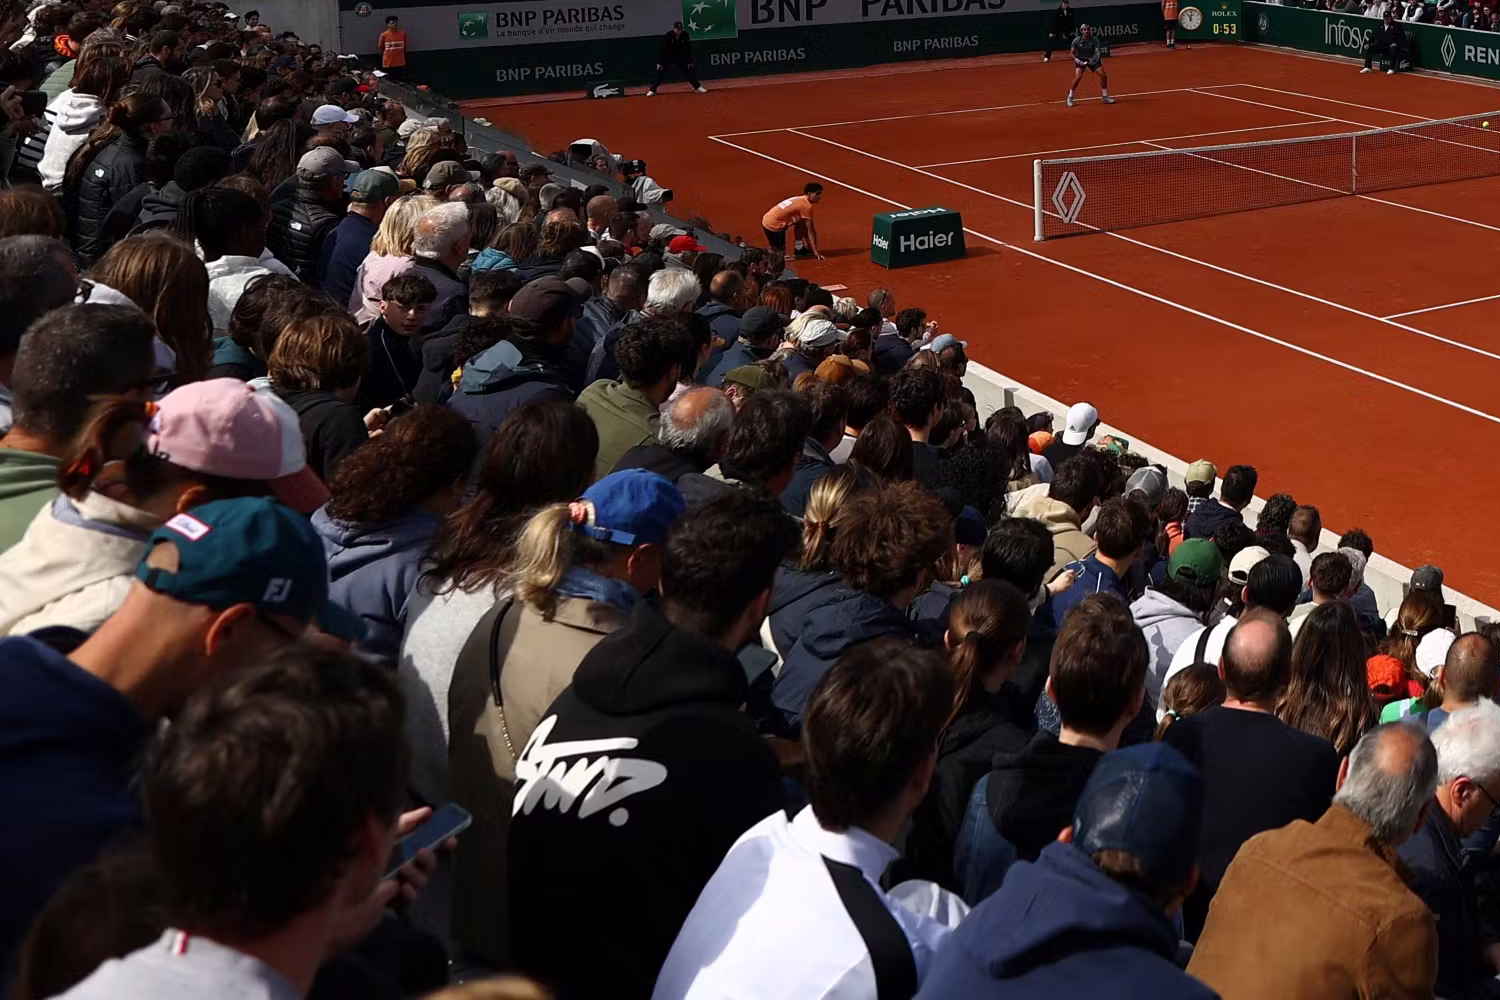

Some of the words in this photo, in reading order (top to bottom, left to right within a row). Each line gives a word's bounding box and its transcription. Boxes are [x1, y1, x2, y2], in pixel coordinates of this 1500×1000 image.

[495, 10, 537, 28] BNP
[542, 5, 625, 26] PARIBAS
[507, 29, 536, 37] banque
[538, 27, 555, 35] d'un
[585, 25, 597, 33] qui
[599, 23, 625, 32] change
[1090, 24, 1138, 37] PARIBAS
[1213, 23, 1237, 35] 0:53
[893, 39, 921, 53] BNP
[924, 34, 979, 50] PARIBAS
[710, 51, 741, 66] BNP
[744, 47, 806, 63] PARIBAS
[495, 66, 532, 82] BNP
[537, 62, 604, 80] PARIBAS
[872, 233, 889, 251] Haier
[900, 230, 954, 253] Haier
